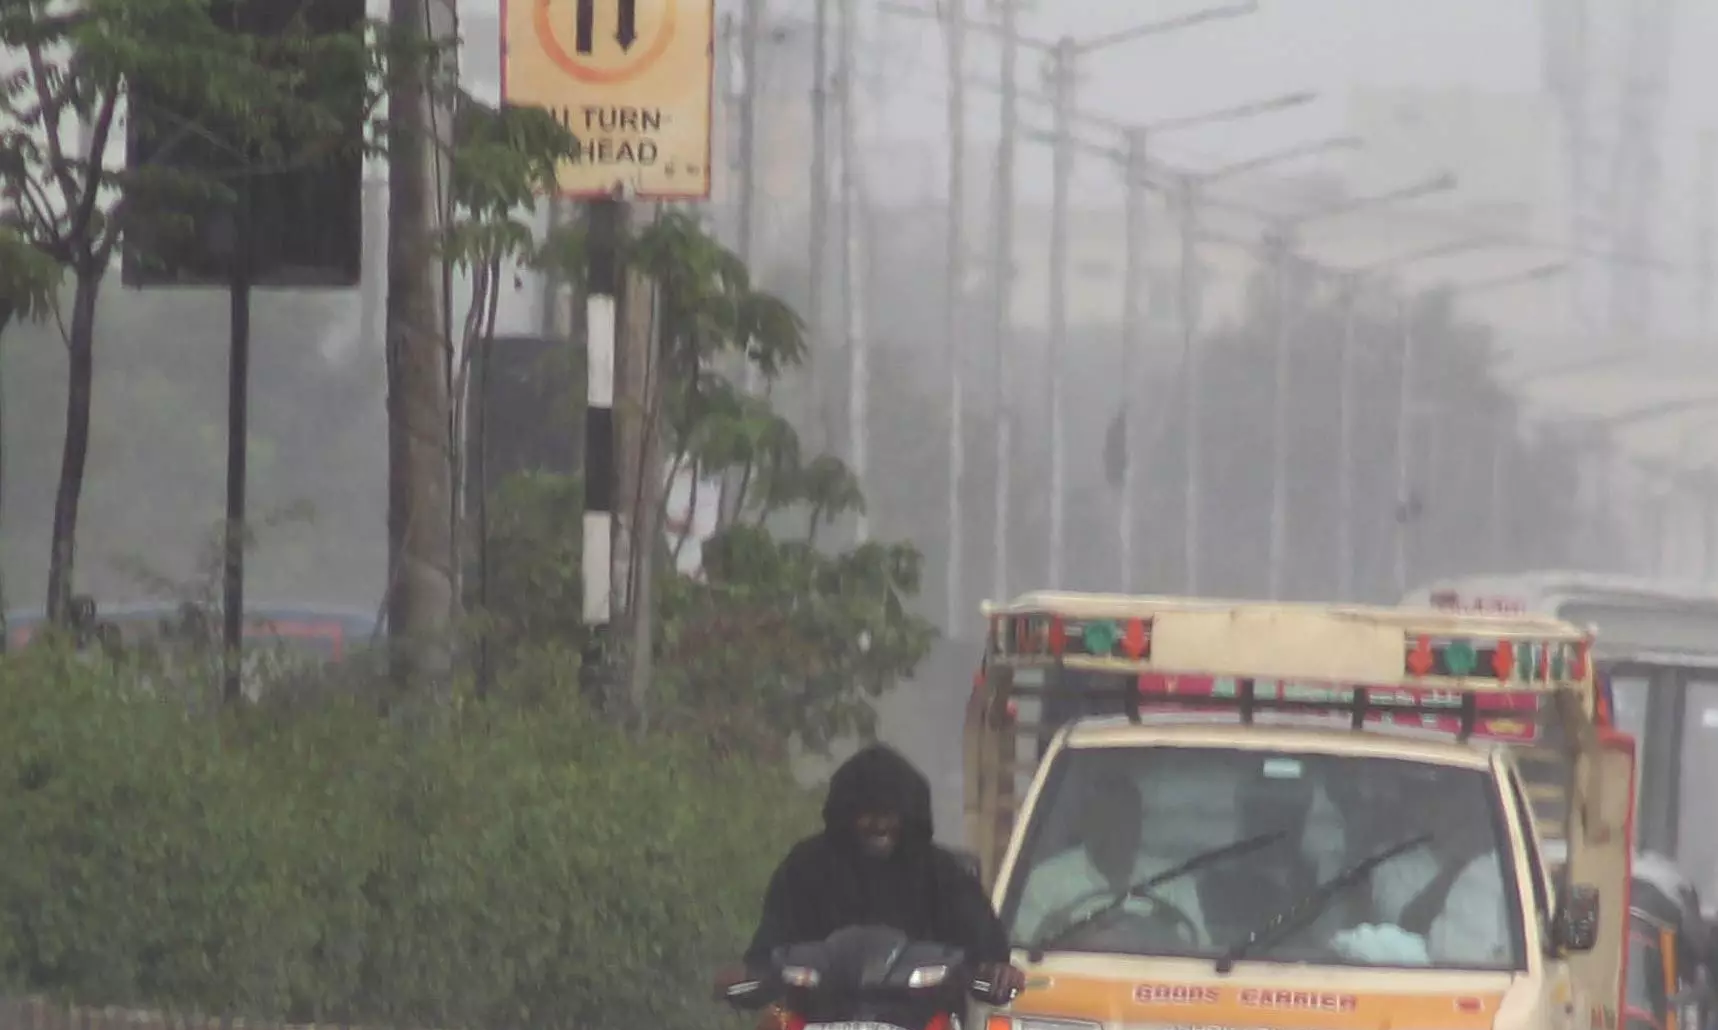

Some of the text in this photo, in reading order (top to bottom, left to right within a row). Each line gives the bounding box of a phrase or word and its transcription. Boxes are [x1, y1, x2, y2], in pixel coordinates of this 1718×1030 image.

[582, 106, 661, 134] TURN
[1132, 983, 1358, 1012] GOODS CARRIER
